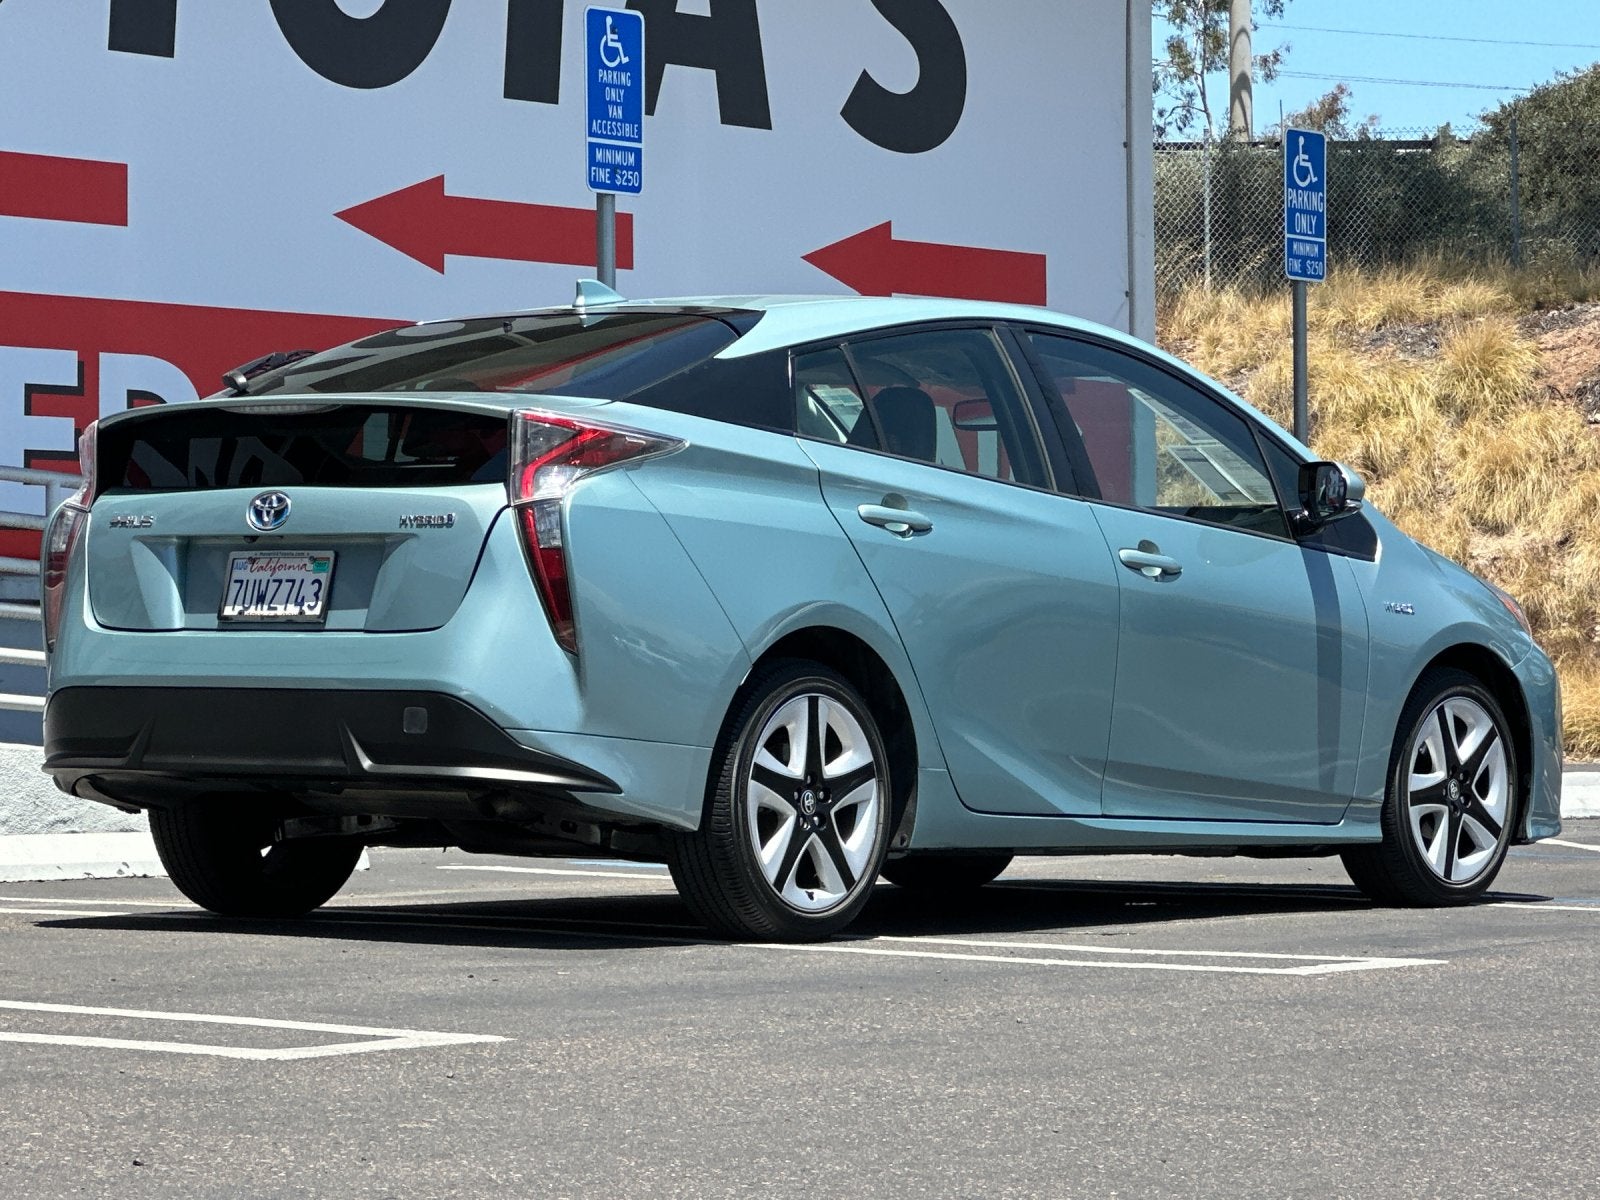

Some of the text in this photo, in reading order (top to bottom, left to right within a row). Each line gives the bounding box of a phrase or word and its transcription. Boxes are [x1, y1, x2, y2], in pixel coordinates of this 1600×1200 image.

[599, 69, 631, 86] PARKING
[605, 87, 625, 103] ONLY
[608, 104, 622, 119] VAN
[592, 120, 638, 138] ACCESSIBLE
[596, 148, 634, 166] MINIMUM
[591, 166, 639, 187] FINE $250
[1288, 188, 1323, 212] PARKING
[1295, 213, 1317, 234] ONLY
[1293, 241, 1318, 257] MINIMUM
[1288, 257, 1322, 275] FINE $250
[399, 513, 447, 529] HYBRID
[248, 557, 313, 577] California
[231, 578, 323, 612] 7UWZ743
